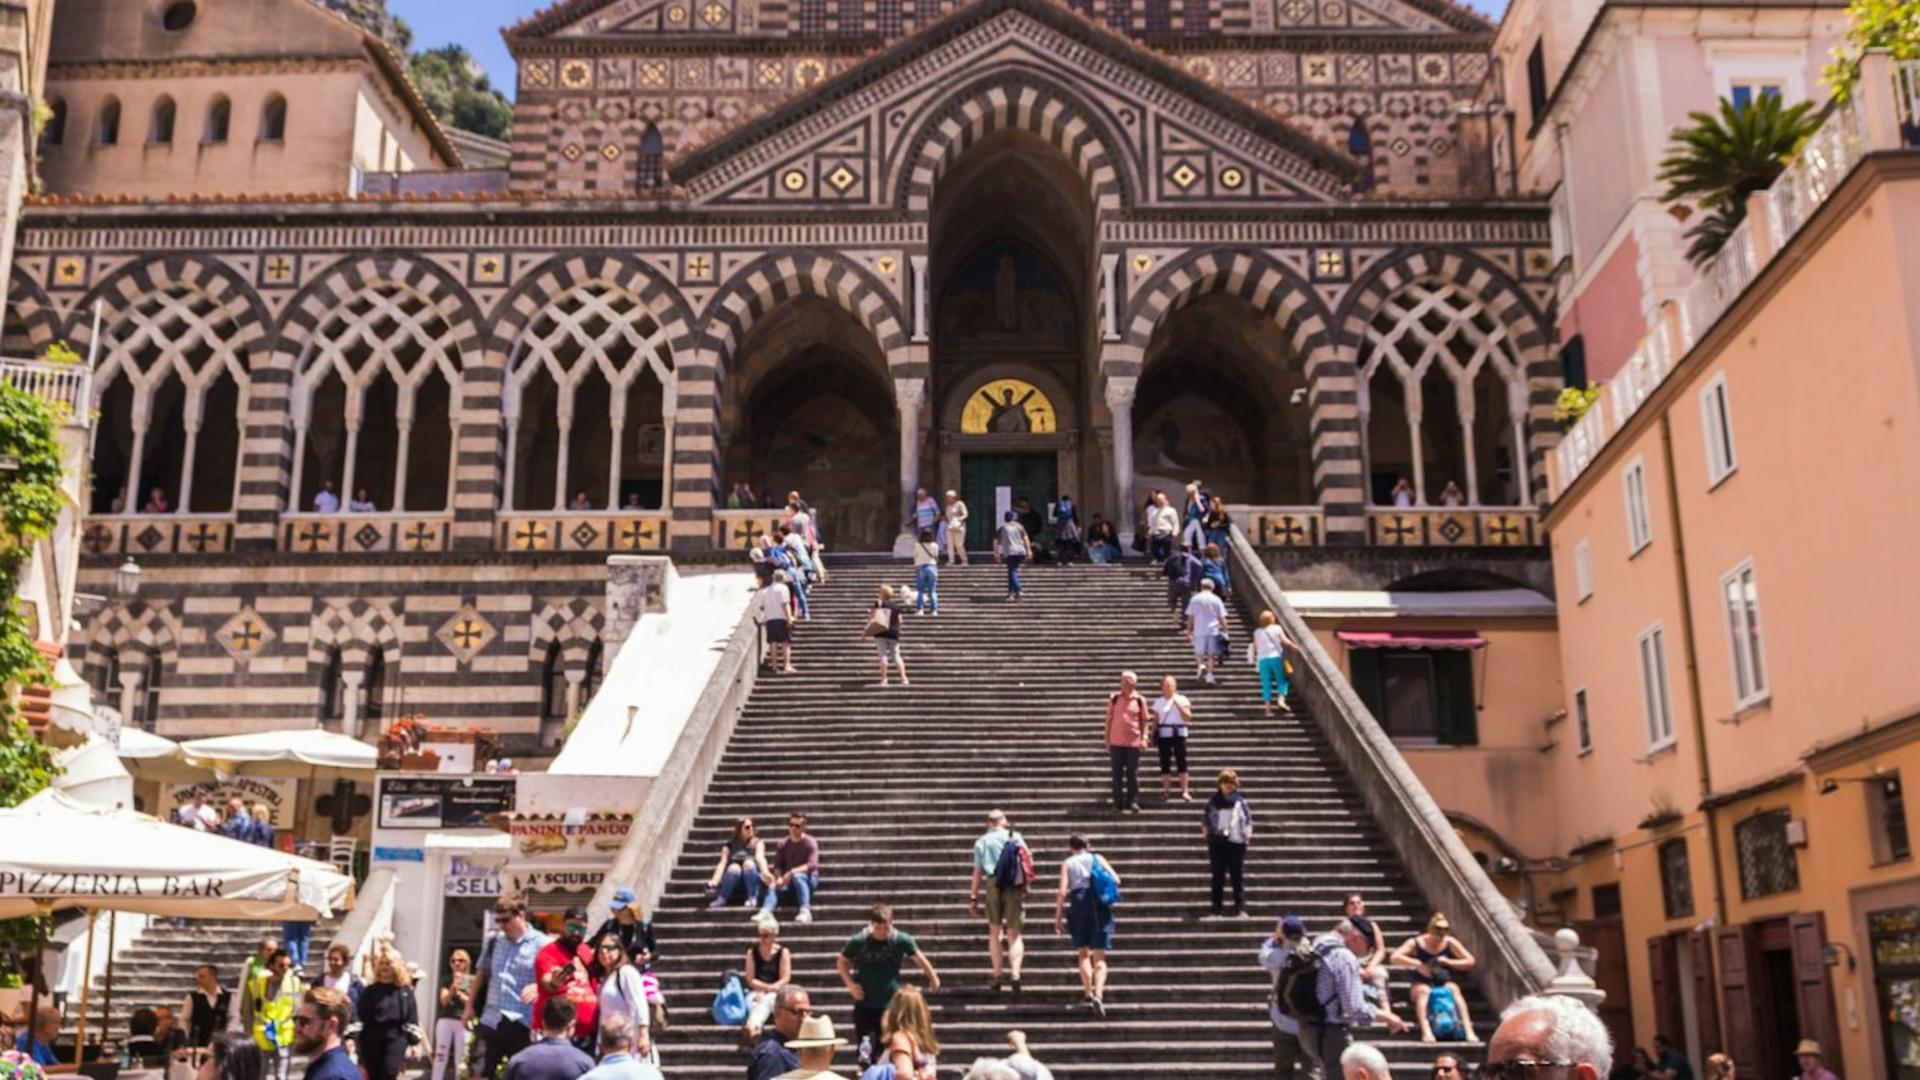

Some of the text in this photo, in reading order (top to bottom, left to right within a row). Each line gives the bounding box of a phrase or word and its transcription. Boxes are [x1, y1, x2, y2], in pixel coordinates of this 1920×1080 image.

[511, 825, 563, 836] PANINI
[566, 824, 577, 836] E
[0, 871, 225, 897] PIZZERIA BAR
